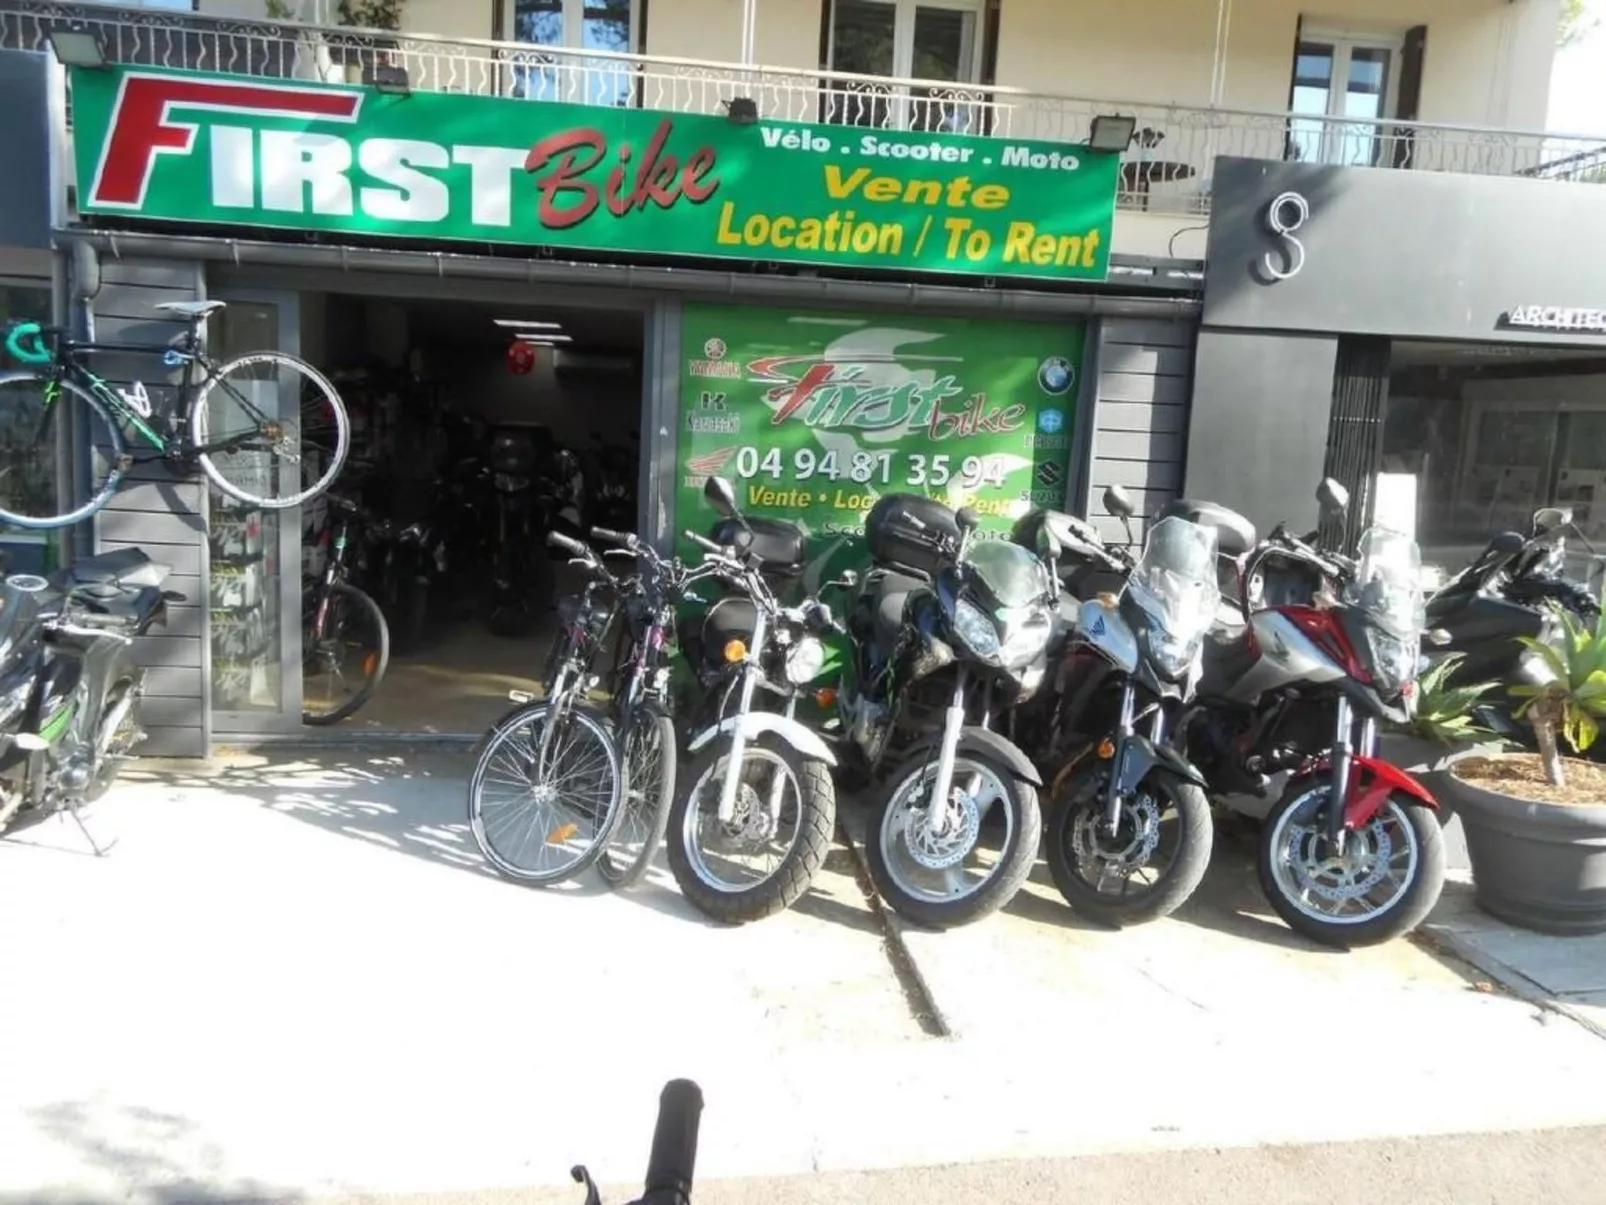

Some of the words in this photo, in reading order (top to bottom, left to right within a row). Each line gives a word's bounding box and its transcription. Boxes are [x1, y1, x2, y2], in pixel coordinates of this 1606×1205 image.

[87, 71, 526, 227] FIRST
[526, 119, 721, 229] Bike
[760, 127, 831, 153] Vélo
[860, 135, 974, 163] Scooter
[1001, 146, 1080, 171] Moto
[824, 165, 1010, 209] Vente
[717, 202, 903, 255] Location
[944, 217, 991, 261] To
[1003, 221, 1100, 267] Rent
[928, 393, 1026, 441] bike
[736, 446, 783, 479] 04
[794, 447, 840, 481] 94
[850, 450, 891, 484] 81
[907, 454, 950, 486] 35
[961, 456, 1006, 489] 94
[749, 486, 810, 508] Vente
